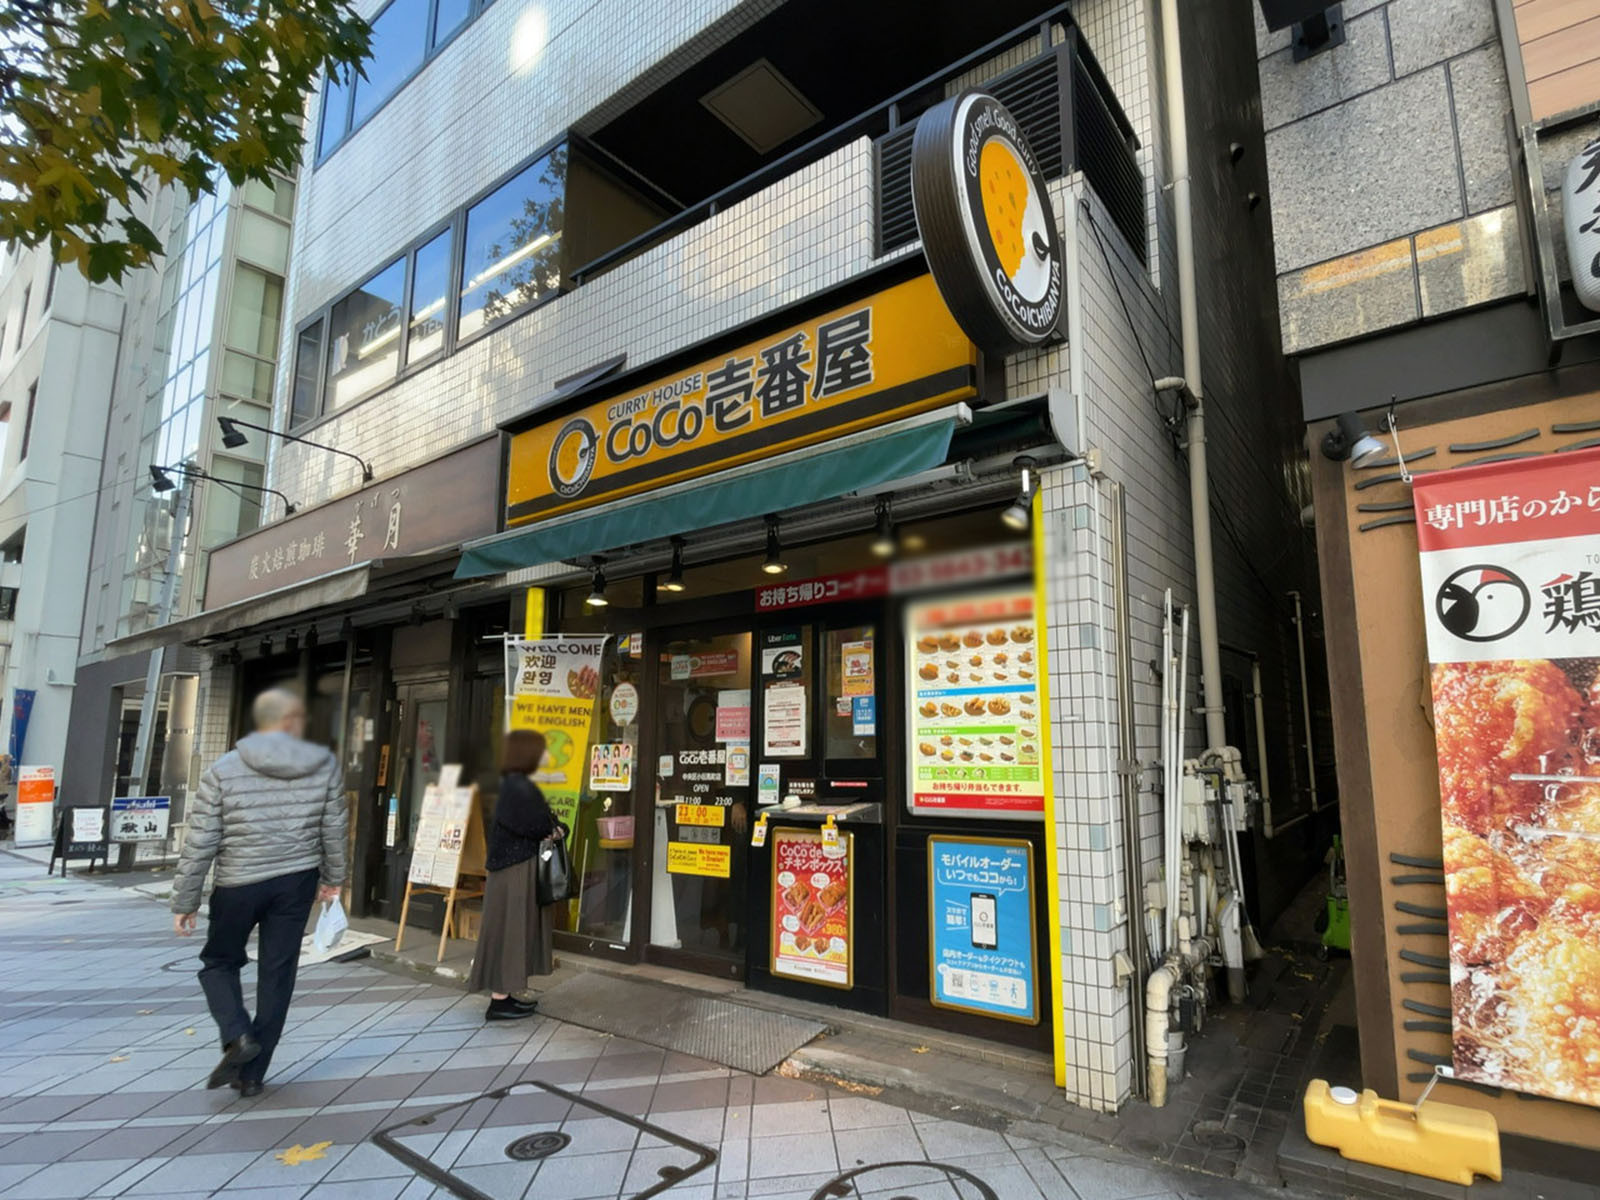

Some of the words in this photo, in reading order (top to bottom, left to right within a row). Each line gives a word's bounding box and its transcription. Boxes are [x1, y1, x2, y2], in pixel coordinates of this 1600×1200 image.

[966, 122, 979, 177] Good
[993, 109, 1017, 141] Good
[1016, 137, 1038, 175] curry
[607, 391, 650, 421] CURRY
[652, 374, 702, 405] HOUSE
[768, 635, 782, 643] Uber
[521, 643, 601, 656] WELCOME
[524, 655, 557, 669] 欢迎
[517, 703, 534, 713] WE
[537, 704, 566, 715] HAVE
[523, 715, 535, 725] IN
[538, 717, 586, 728] ENGLISH
[693, 784, 710, 793] OPEN
[126, 799, 156, 810] Asahi
[685, 796, 702, 805] 11:00
[714, 796, 733, 806] 23:00
[780, 844, 808, 857] CoCo
[784, 857, 843, 873] チキンボックス
[941, 853, 1021, 871] モバイルオーダー
